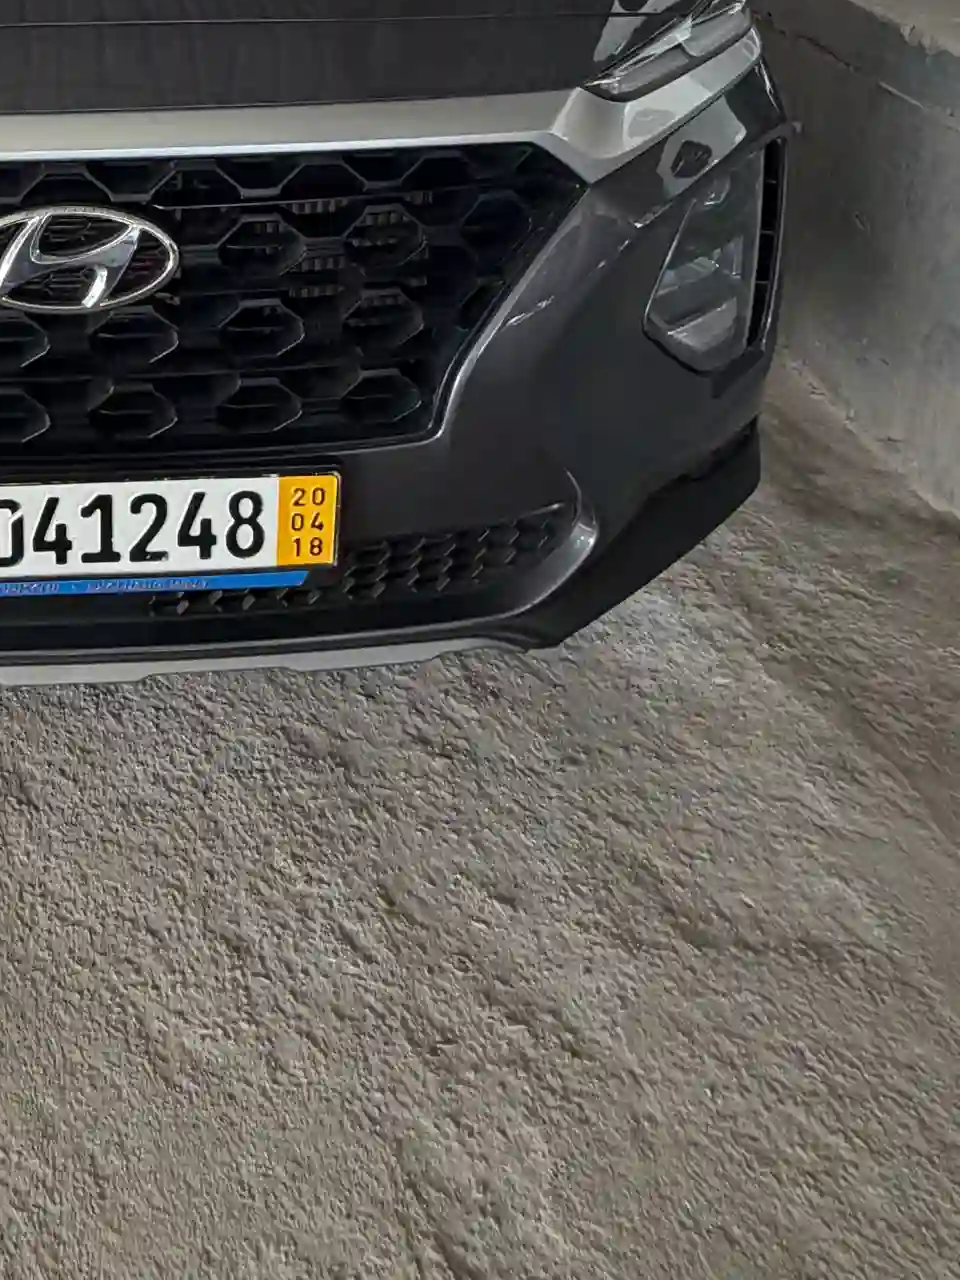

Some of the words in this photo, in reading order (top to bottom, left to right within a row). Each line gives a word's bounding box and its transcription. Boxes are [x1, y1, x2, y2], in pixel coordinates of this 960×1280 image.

[291, 487, 325, 507] 20
[290, 513, 325, 532] 04
[291, 537, 324, 558] 18
